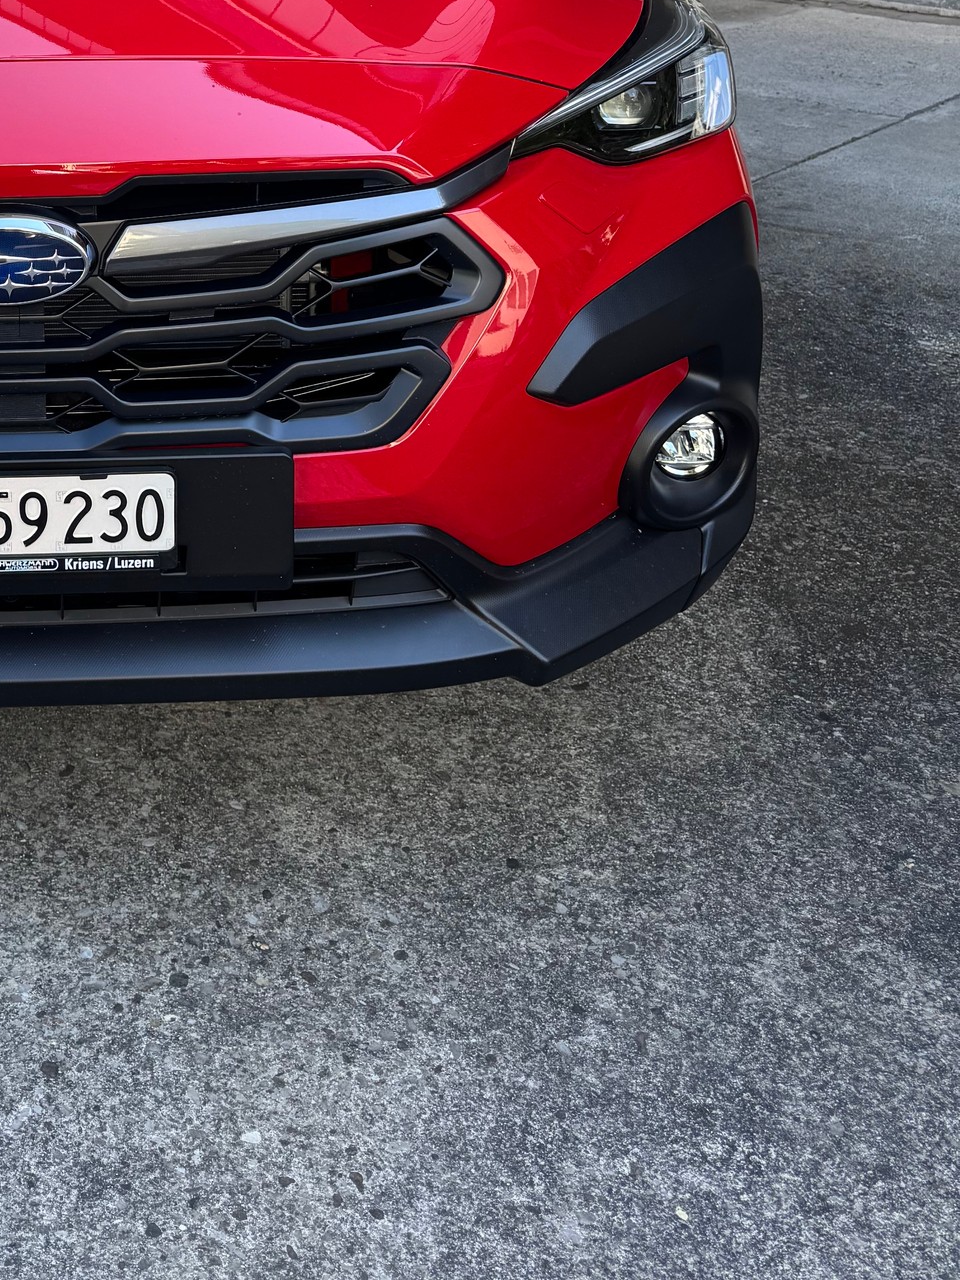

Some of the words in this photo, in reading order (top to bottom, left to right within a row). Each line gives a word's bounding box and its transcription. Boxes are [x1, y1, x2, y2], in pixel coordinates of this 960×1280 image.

[64, 558, 104, 570] Kriens
[106, 557, 112, 570] /
[114, 557, 154, 569] Luzern
